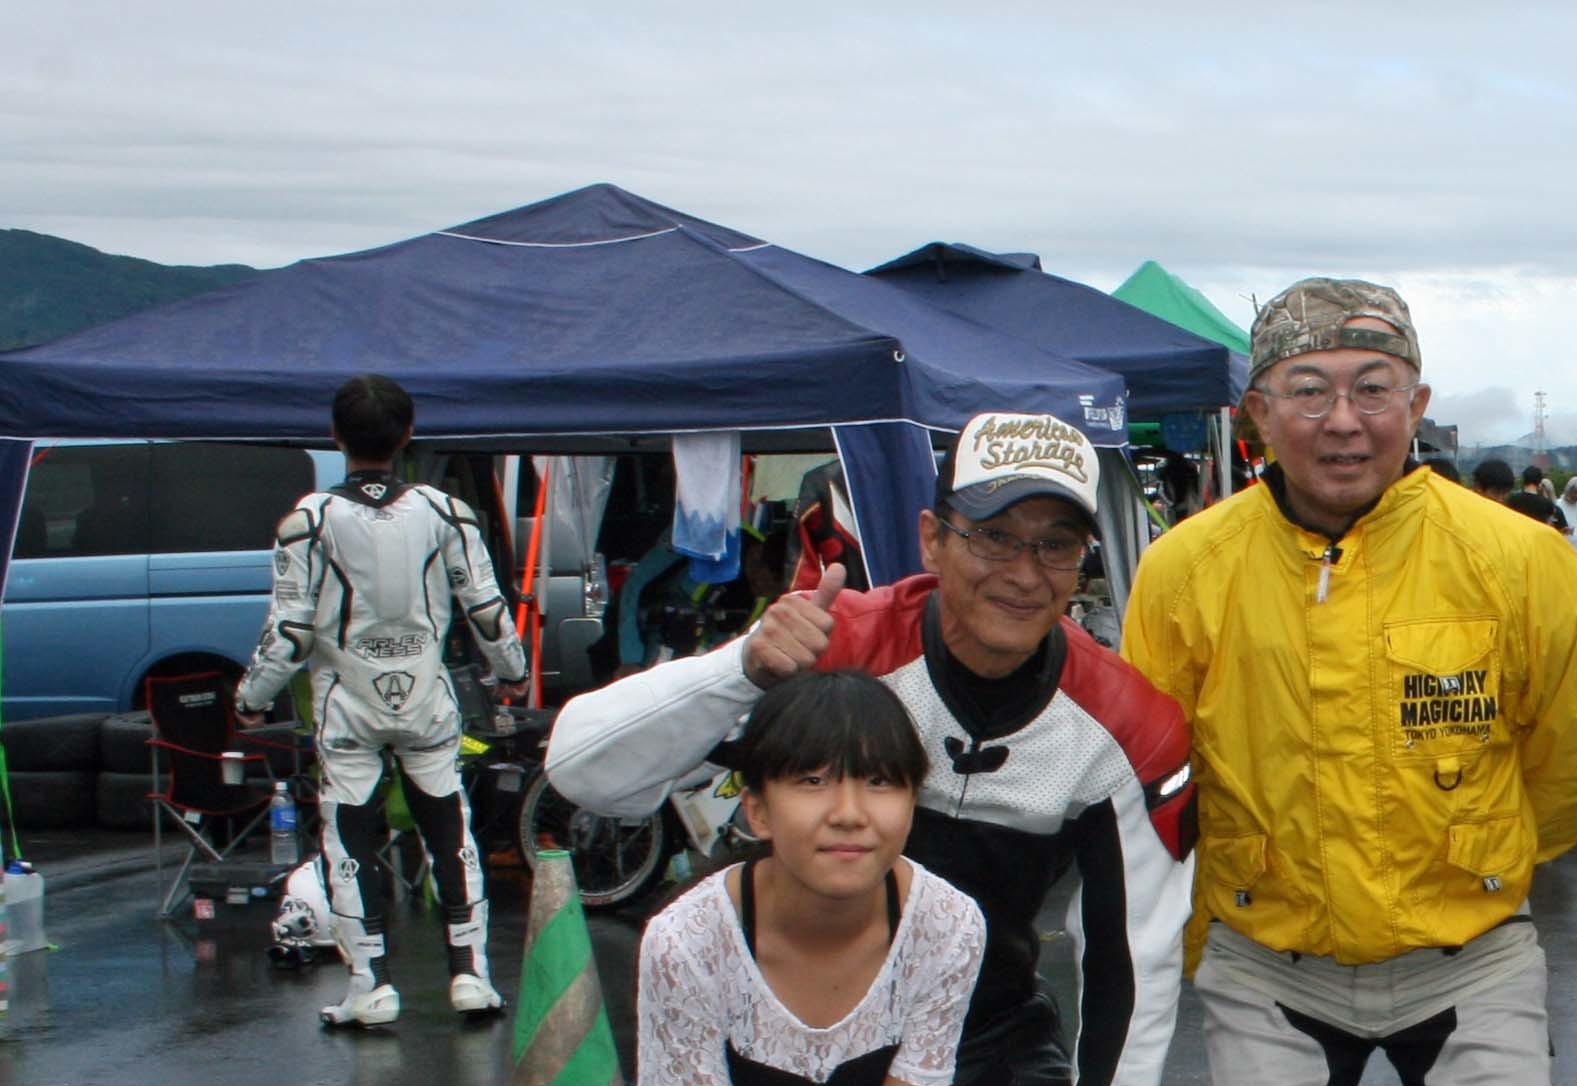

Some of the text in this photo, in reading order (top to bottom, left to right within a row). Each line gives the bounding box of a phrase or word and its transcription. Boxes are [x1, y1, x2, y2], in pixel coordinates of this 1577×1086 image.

[973, 415, 1084, 451] American
[980, 441, 1089, 484] Storage
[1400, 697, 1498, 727] MAGICIAN
[1405, 729, 1436, 740] TOKYO
